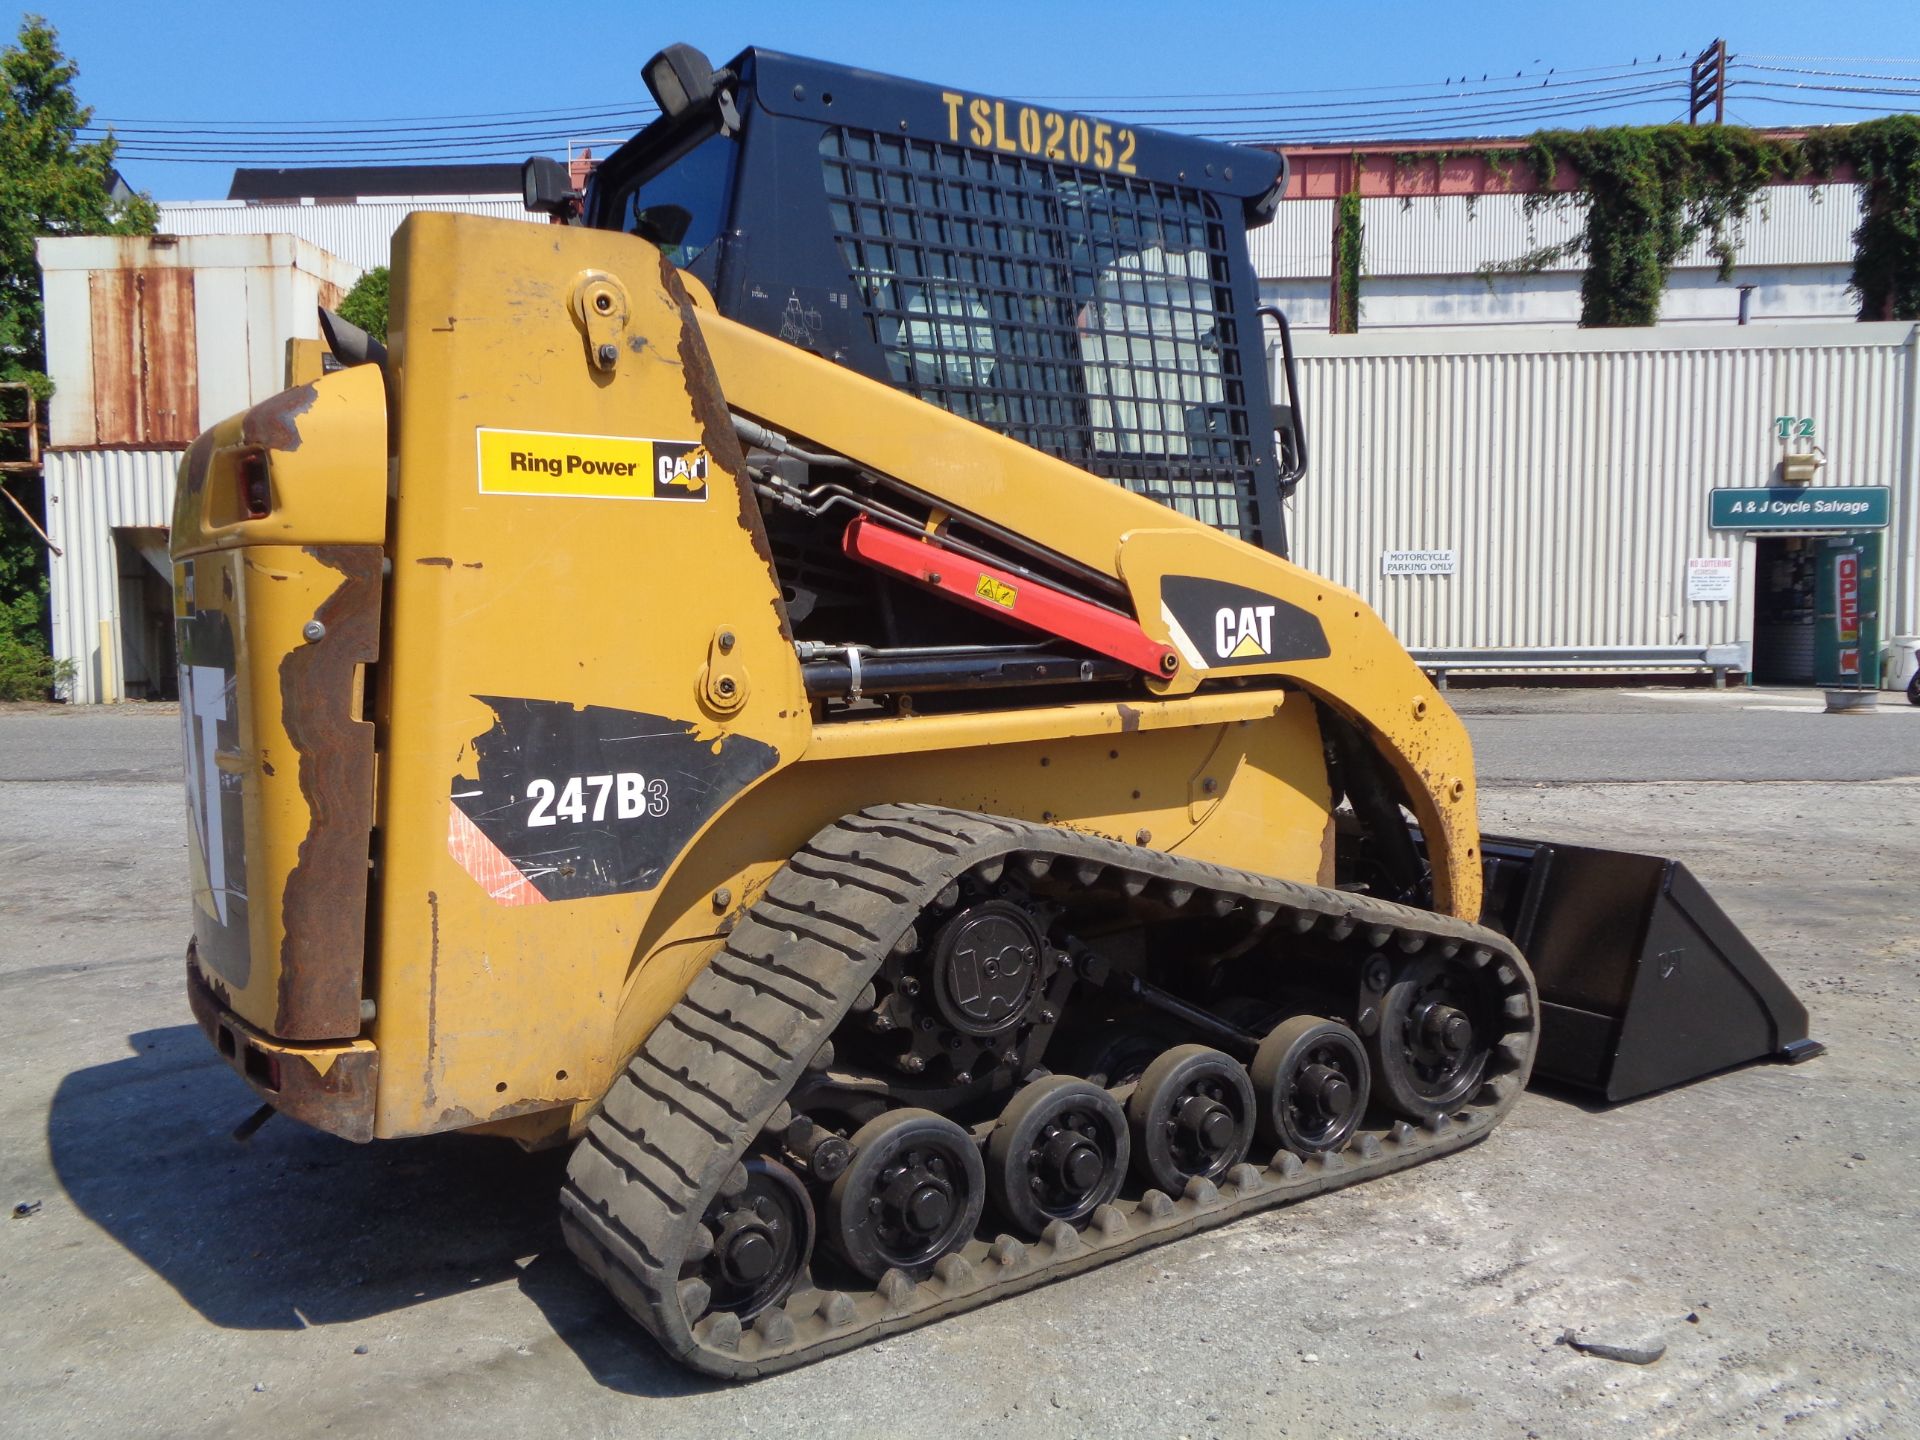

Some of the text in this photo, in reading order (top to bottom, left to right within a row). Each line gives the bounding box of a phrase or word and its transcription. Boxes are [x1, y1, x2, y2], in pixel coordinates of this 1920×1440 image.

[942, 91, 1137, 175] TSL02052
[510, 451, 637, 477] Ring Power
[1731, 500, 1870, 516] A & J Cycle Salvage
[1387, 563, 1454, 571] PARKING ONLY
[1390, 553, 1451, 561] MOTORCYCLE
[1215, 605, 1276, 659] CAT
